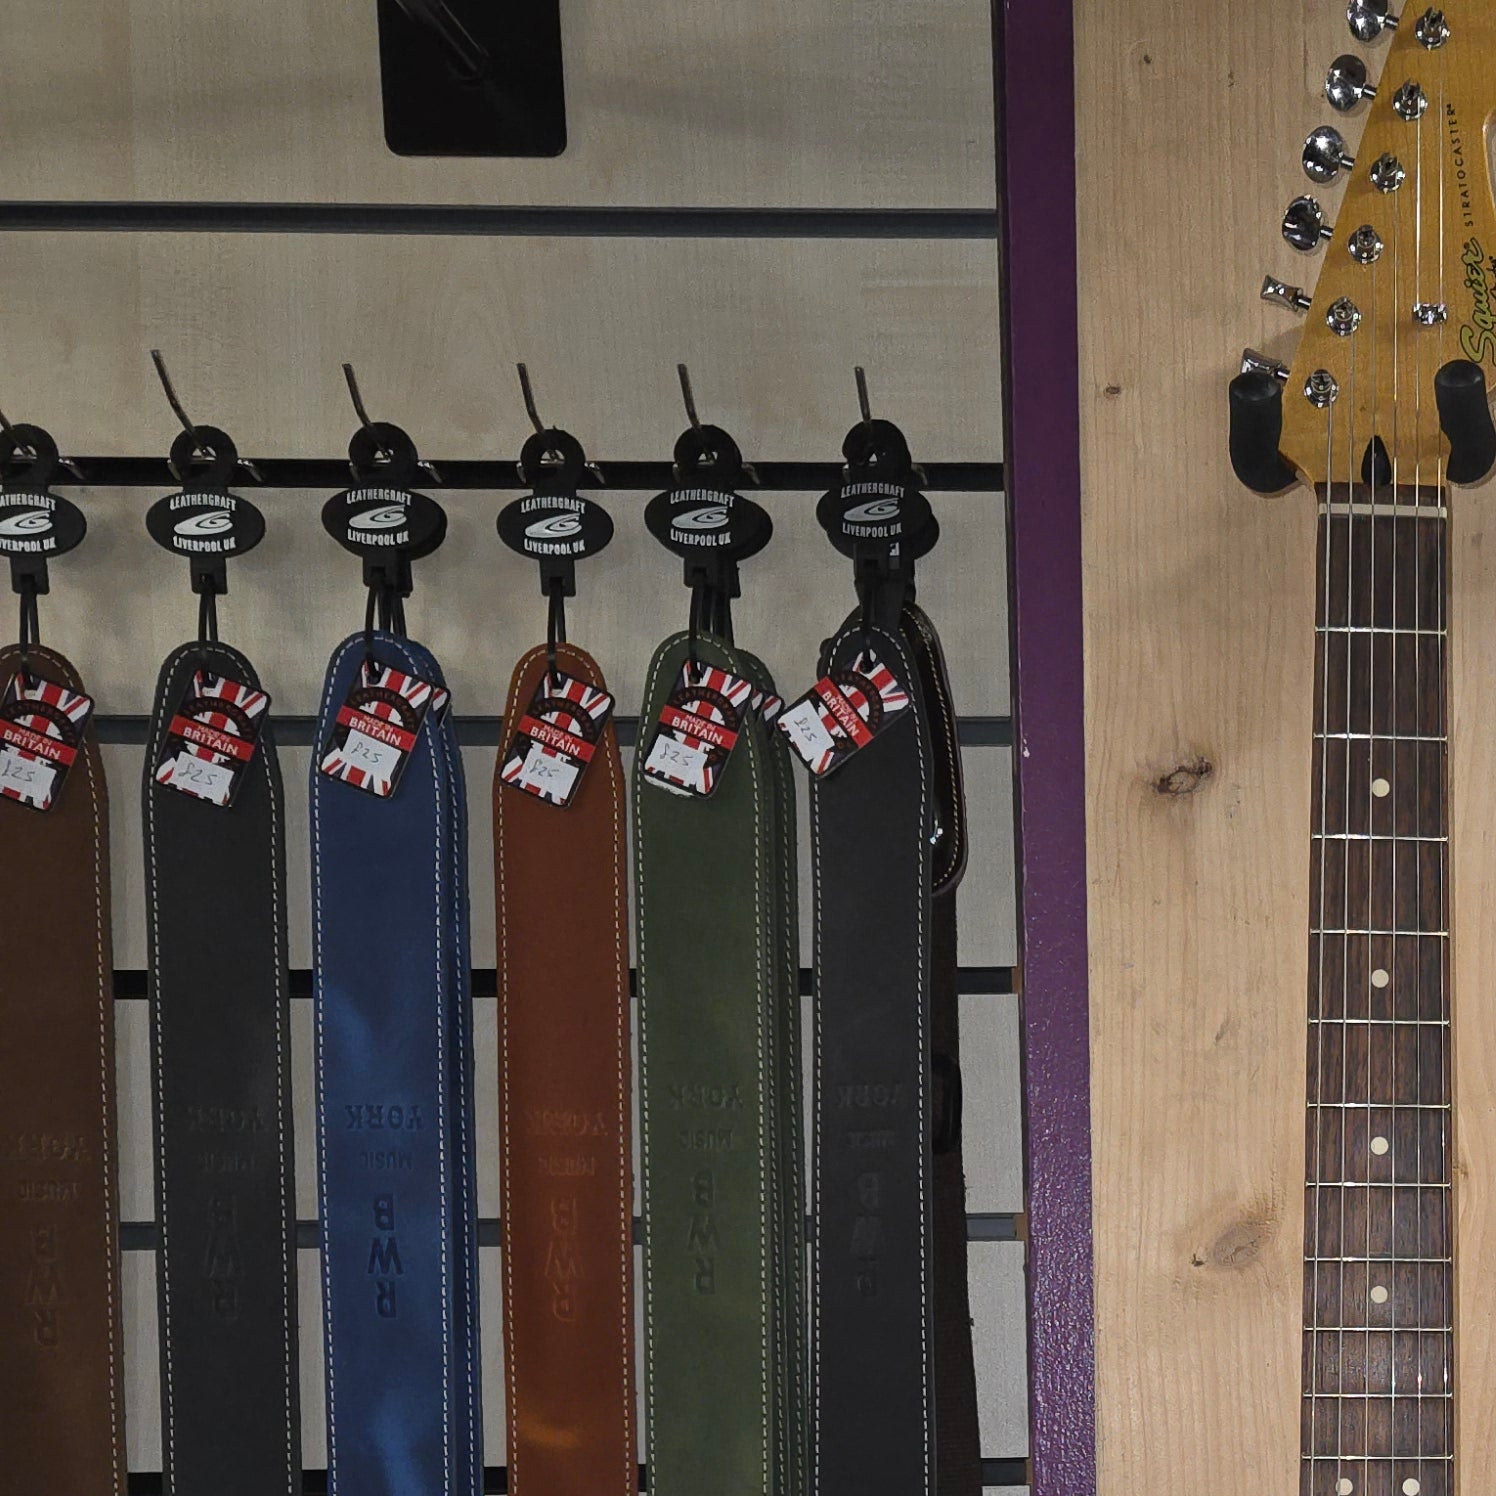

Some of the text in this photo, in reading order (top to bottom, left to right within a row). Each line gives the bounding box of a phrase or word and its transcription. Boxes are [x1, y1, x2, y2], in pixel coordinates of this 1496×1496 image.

[1446, 104, 1474, 227] STRATOCASTER
[43, 537, 56, 551] UK
[173, 536, 236, 552] LIVERPOOL UK
[347, 528, 410, 546] LIVERPOOL UK
[670, 528, 731, 546] LIVERPOOL UK
[842, 522, 902, 538] LIVERPOOL UK
[524, 538, 585, 555] LIVERPOOL UK
[822, 691, 860, 737] BRITAIN
[4, 729, 61, 760] BRITAIN
[183, 727, 238, 756] BRITAIN
[349, 716, 402, 746] BRITAIN
[530, 726, 580, 756] BRITAIN
[672, 716, 723, 745] BRITAIN
[345, 1104, 424, 1131] YORK
